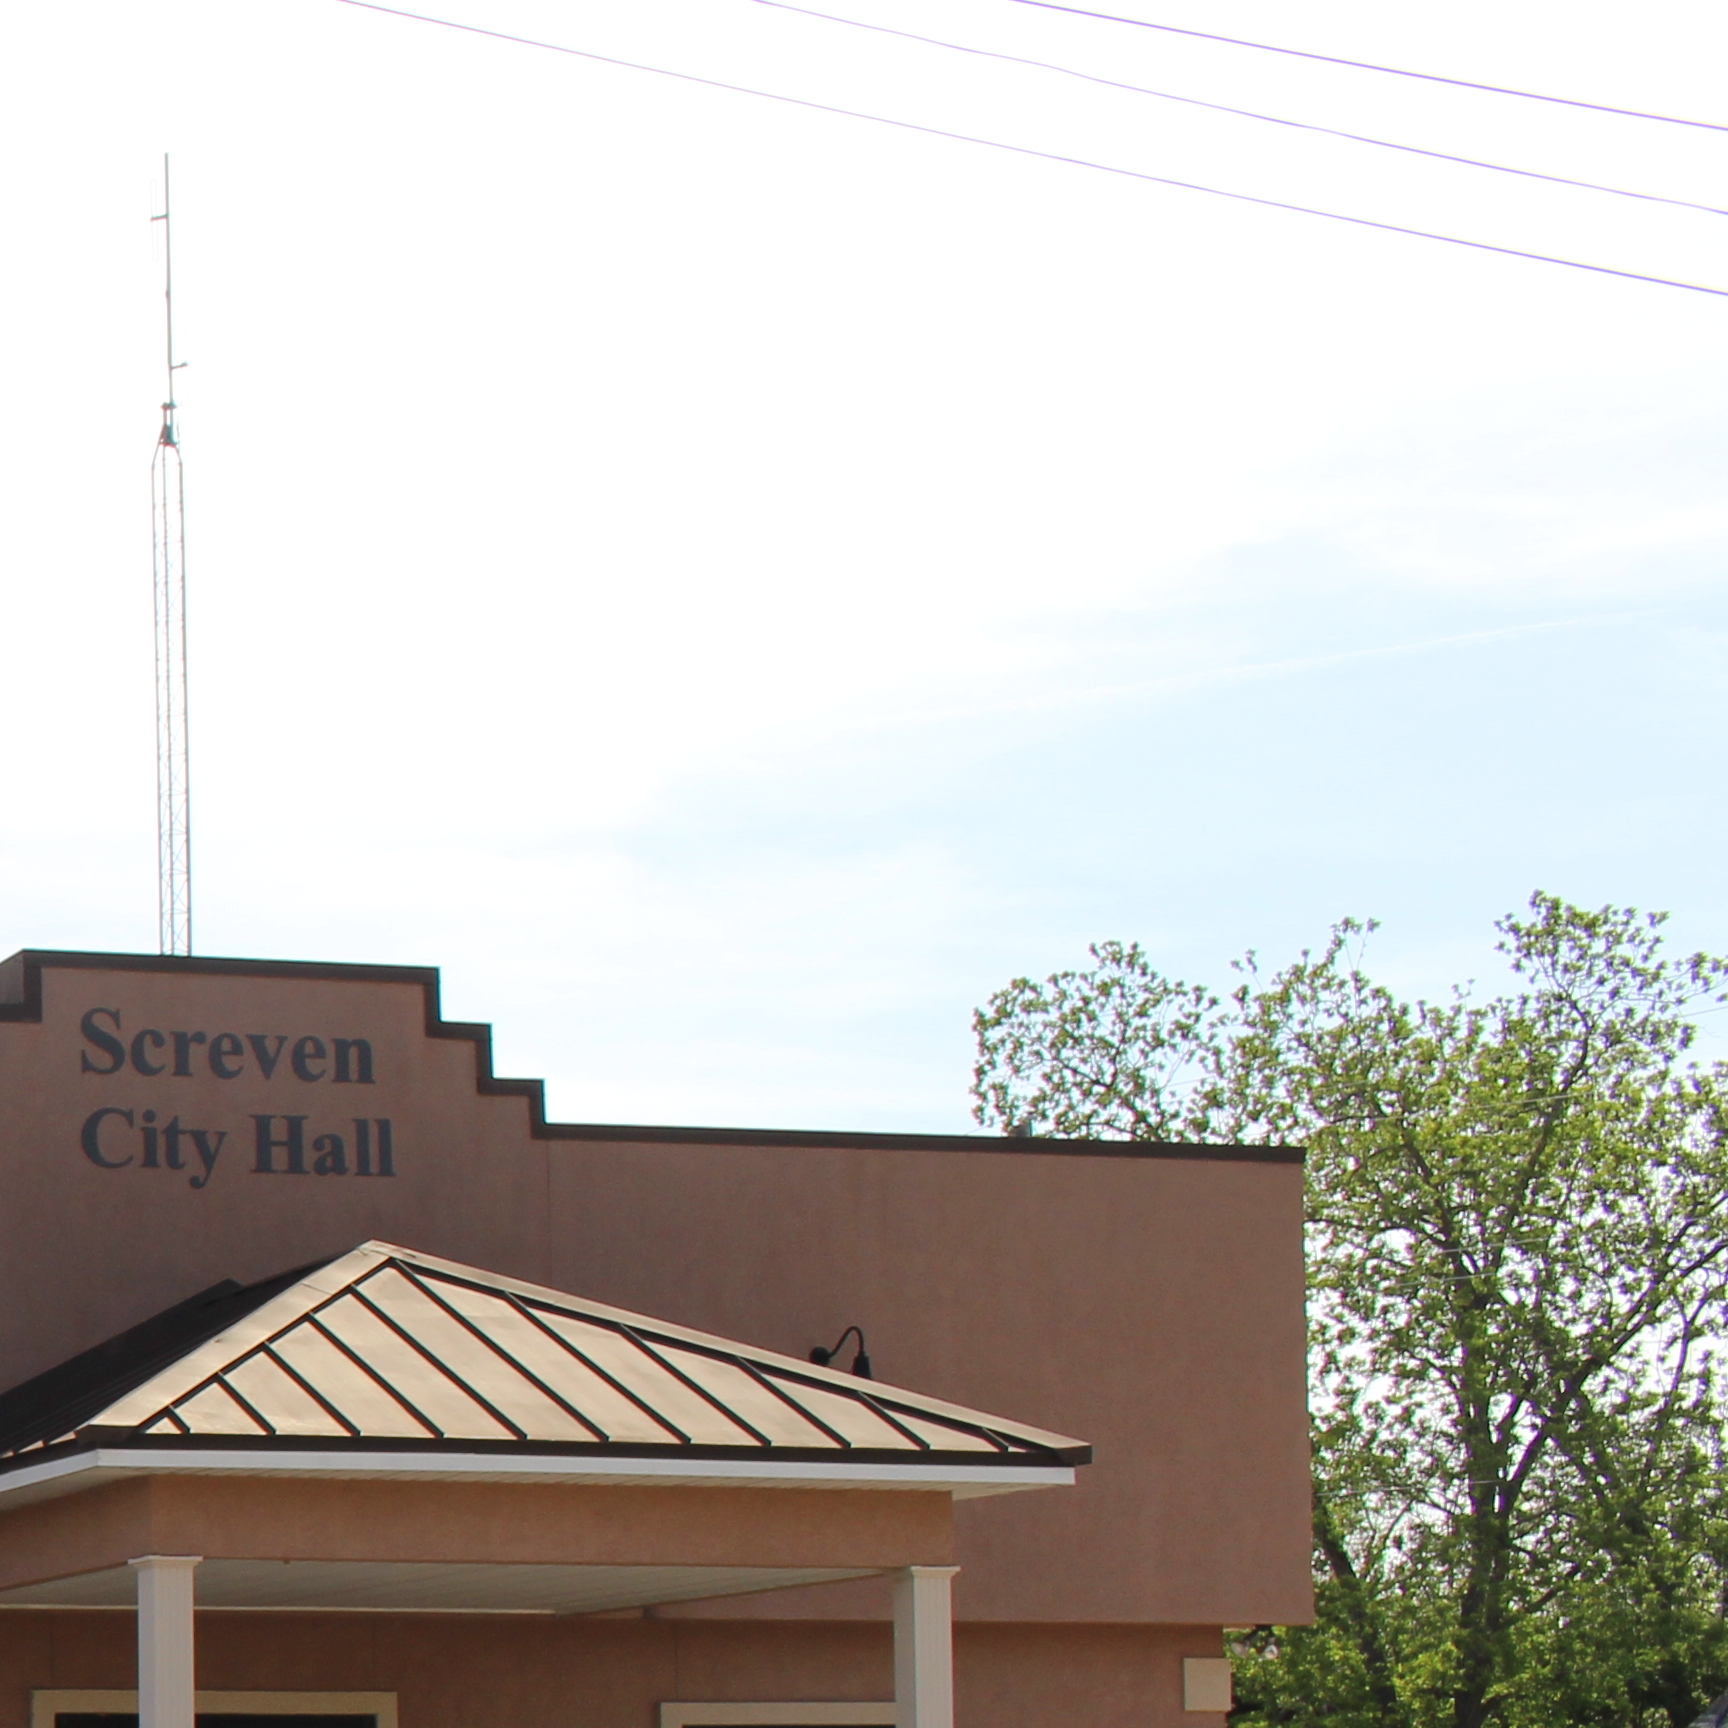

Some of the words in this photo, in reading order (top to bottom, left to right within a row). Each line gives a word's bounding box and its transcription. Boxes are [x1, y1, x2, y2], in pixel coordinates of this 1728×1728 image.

[79, 1007, 377, 1085] Screven
[80, 1106, 229, 1189] City
[249, 1114, 397, 1177] Hall
